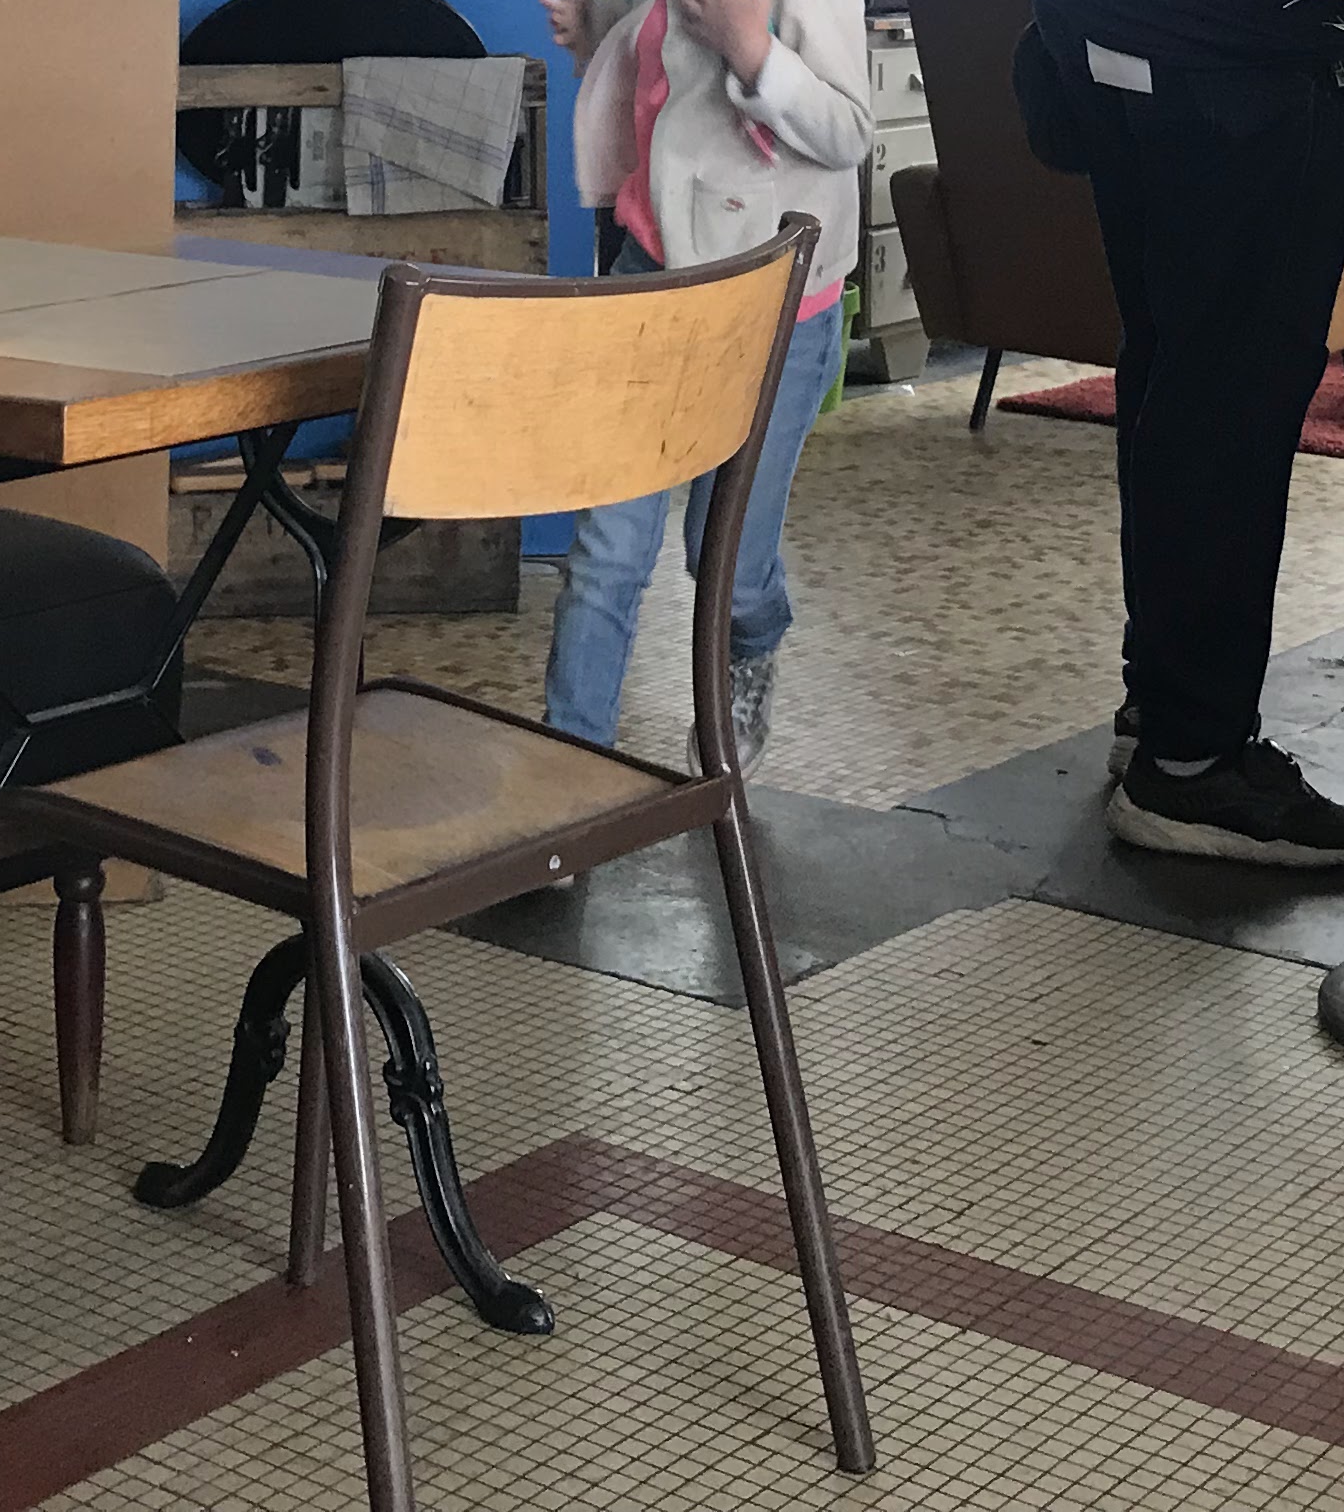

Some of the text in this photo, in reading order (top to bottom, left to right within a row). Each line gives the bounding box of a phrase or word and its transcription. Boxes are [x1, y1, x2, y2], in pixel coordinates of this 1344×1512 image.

[877, 63, 883, 91] 1
[876, 143, 886, 171] 2
[874, 244, 886, 273] 3
